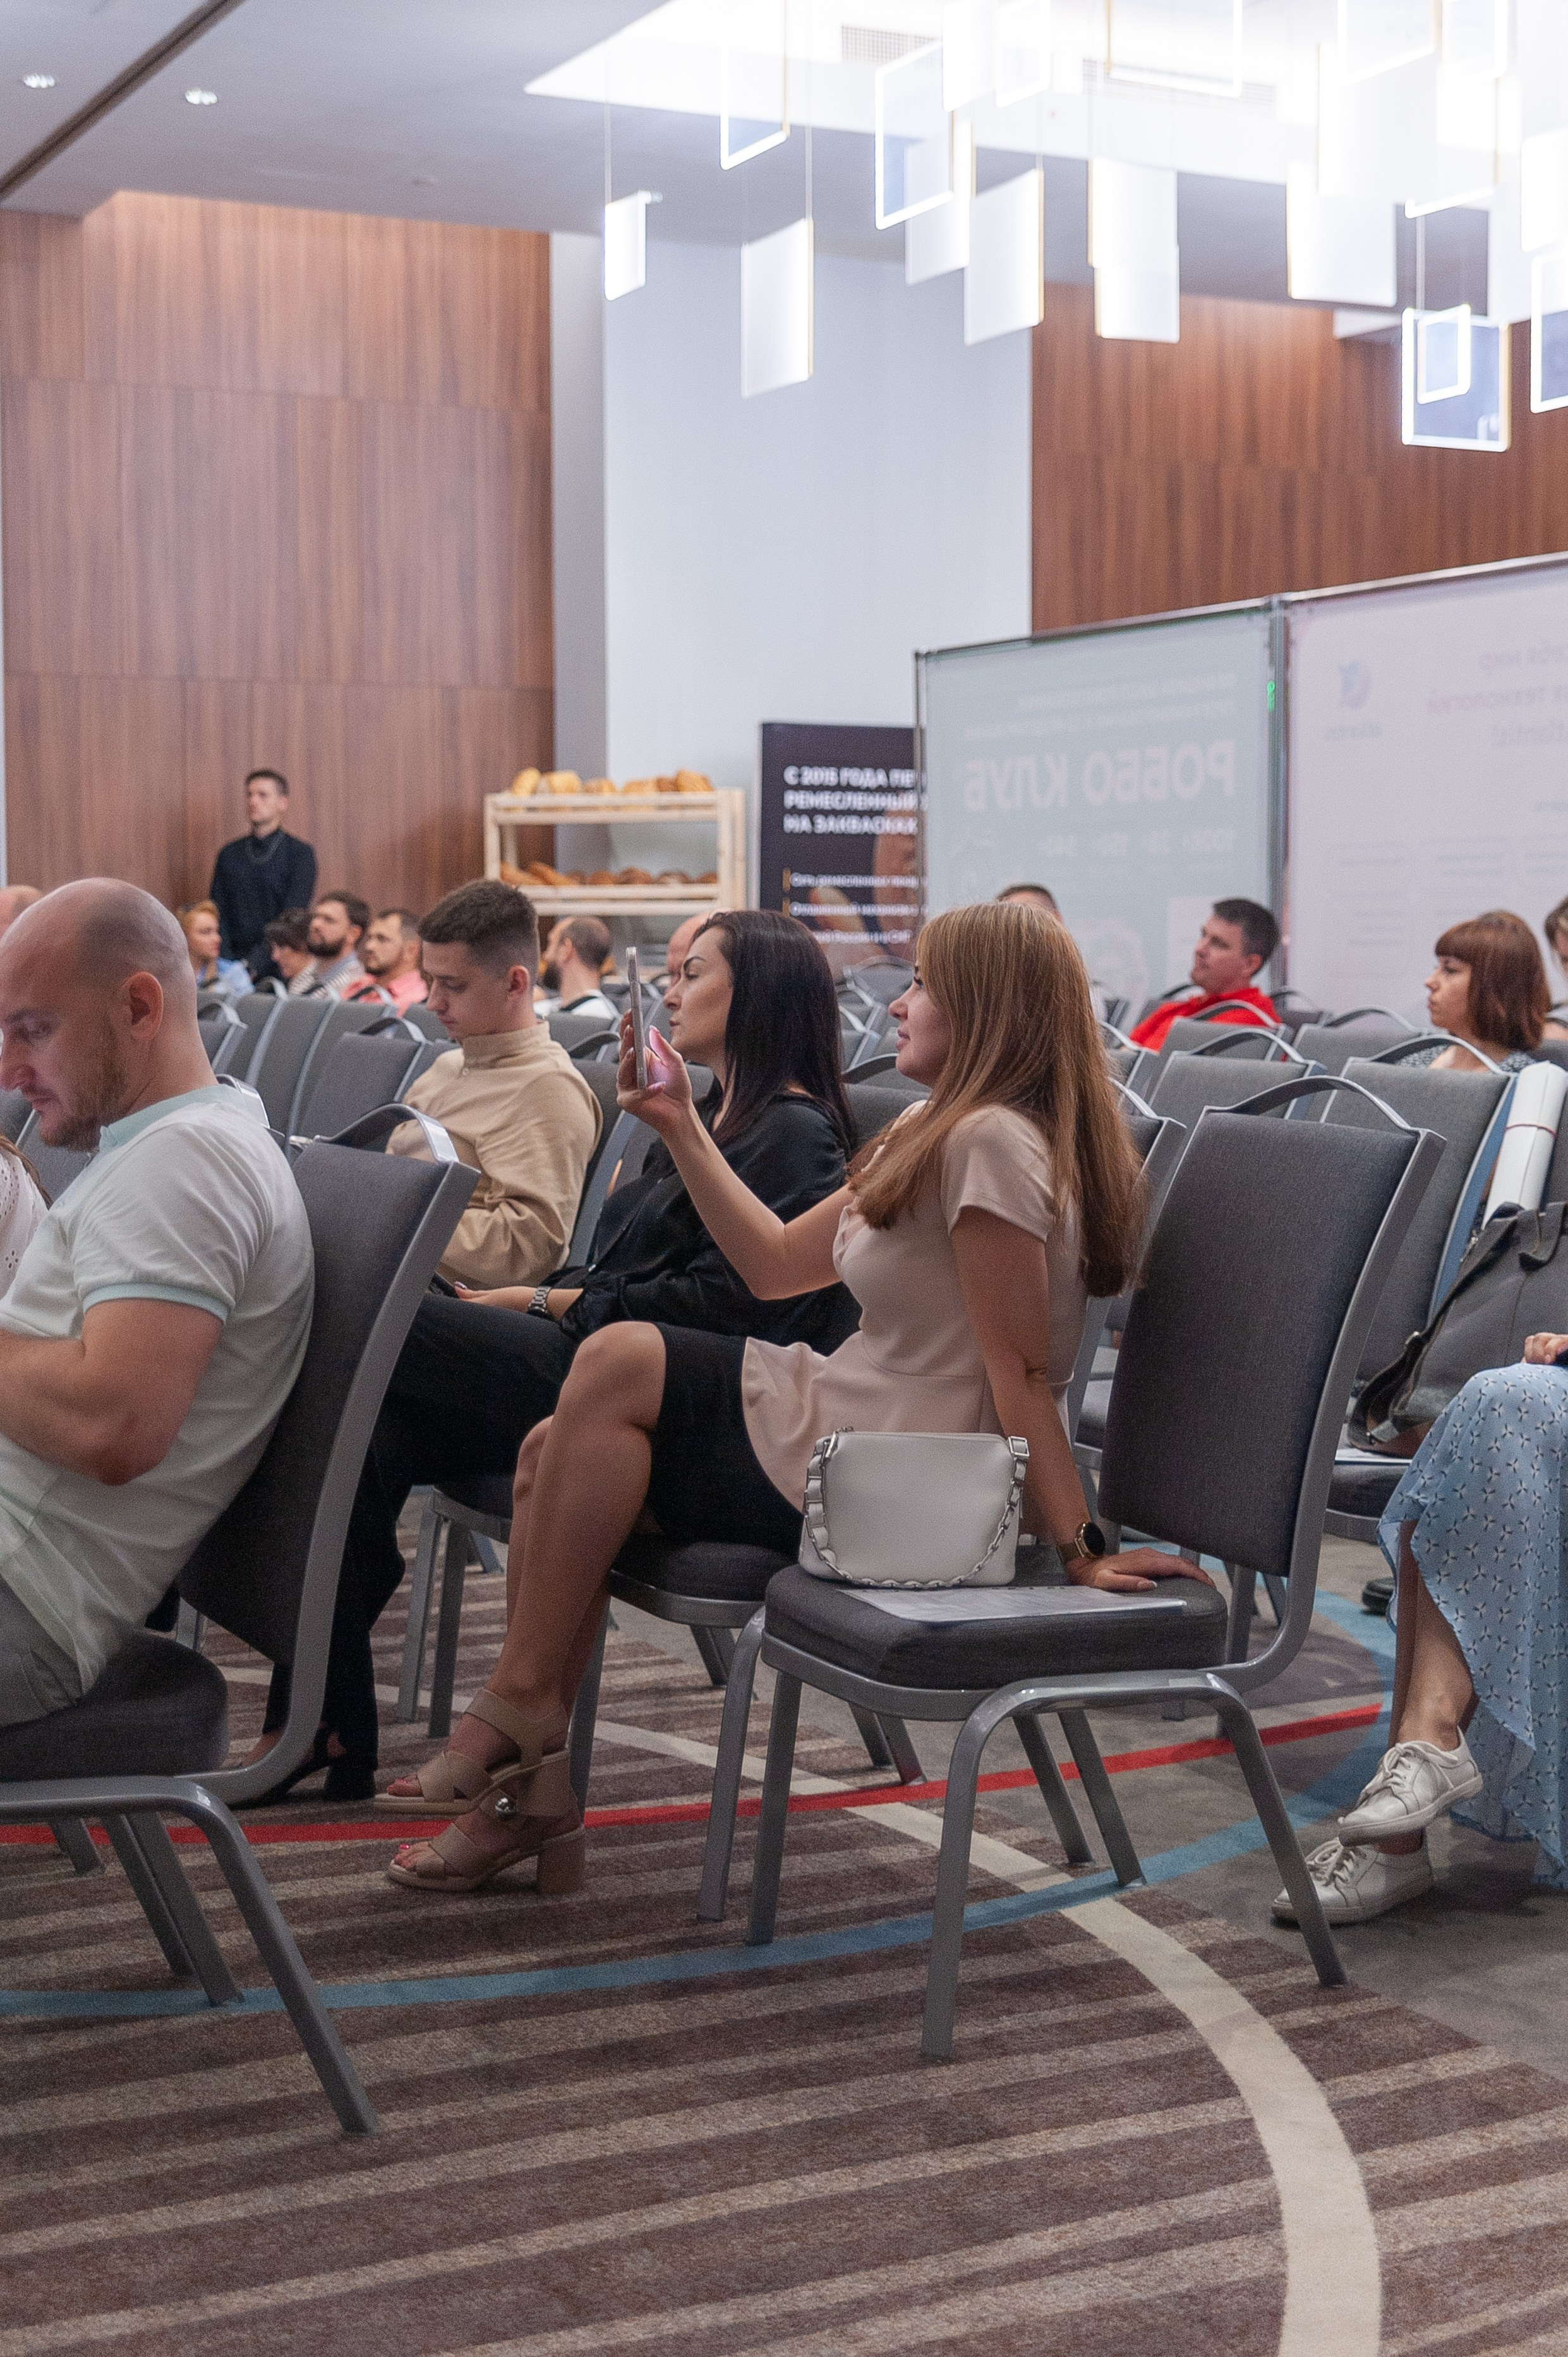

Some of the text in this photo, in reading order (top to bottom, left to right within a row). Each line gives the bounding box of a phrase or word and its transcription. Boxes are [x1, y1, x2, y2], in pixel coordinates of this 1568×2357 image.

[783, 765, 799, 785] С
[840, 767, 888, 789] ГОДА
[783, 790, 917, 811] РЕМЕСЛЕННЫЙ
[783, 813, 812, 834] НА
